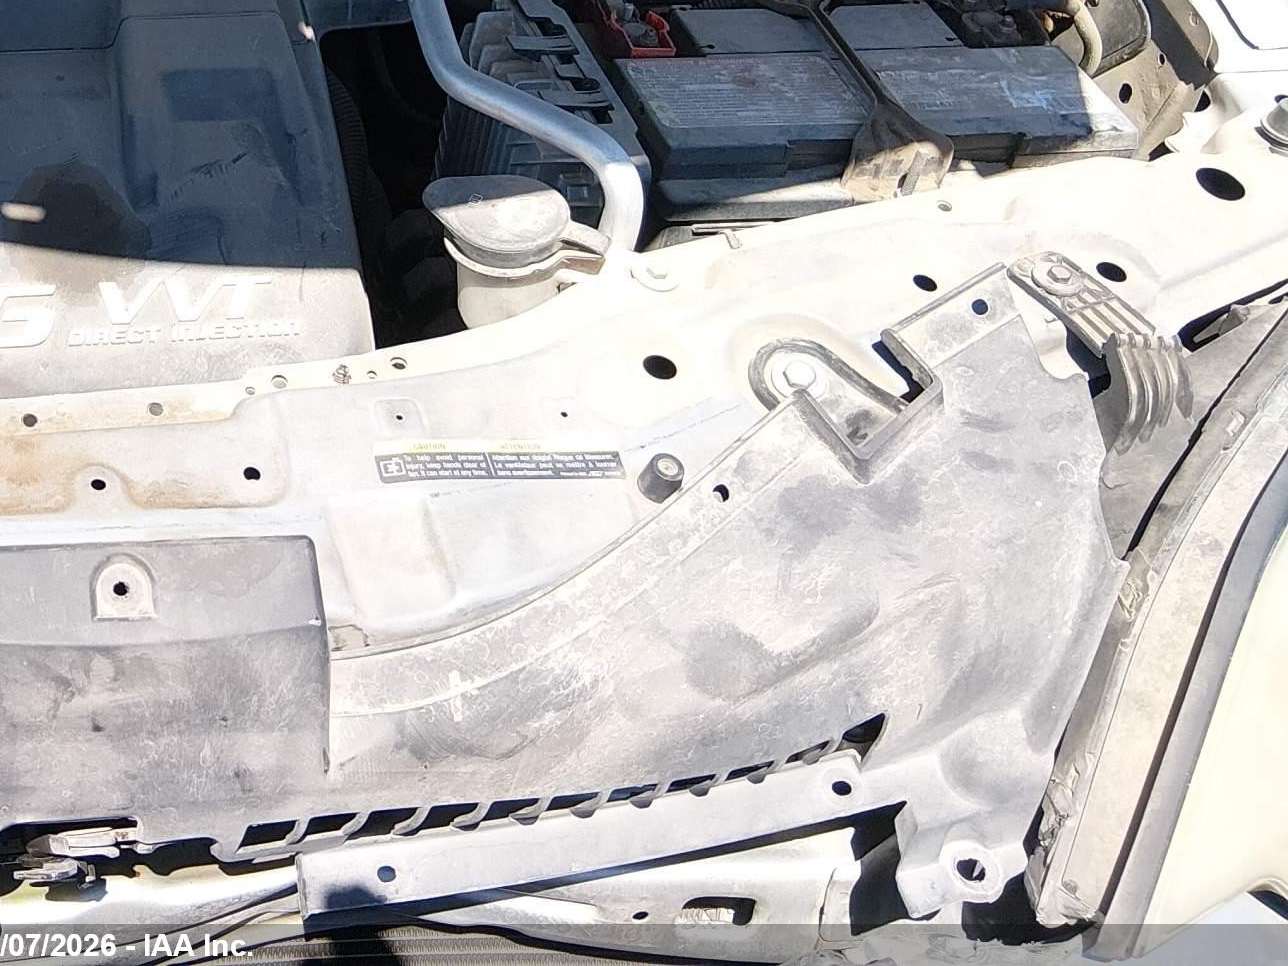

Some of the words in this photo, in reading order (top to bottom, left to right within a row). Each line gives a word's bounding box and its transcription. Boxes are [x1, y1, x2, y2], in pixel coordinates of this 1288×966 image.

[97, 276, 272, 325] VVT
[68, 328, 161, 346] DIRECT
[171, 319, 303, 343] INJECTION
